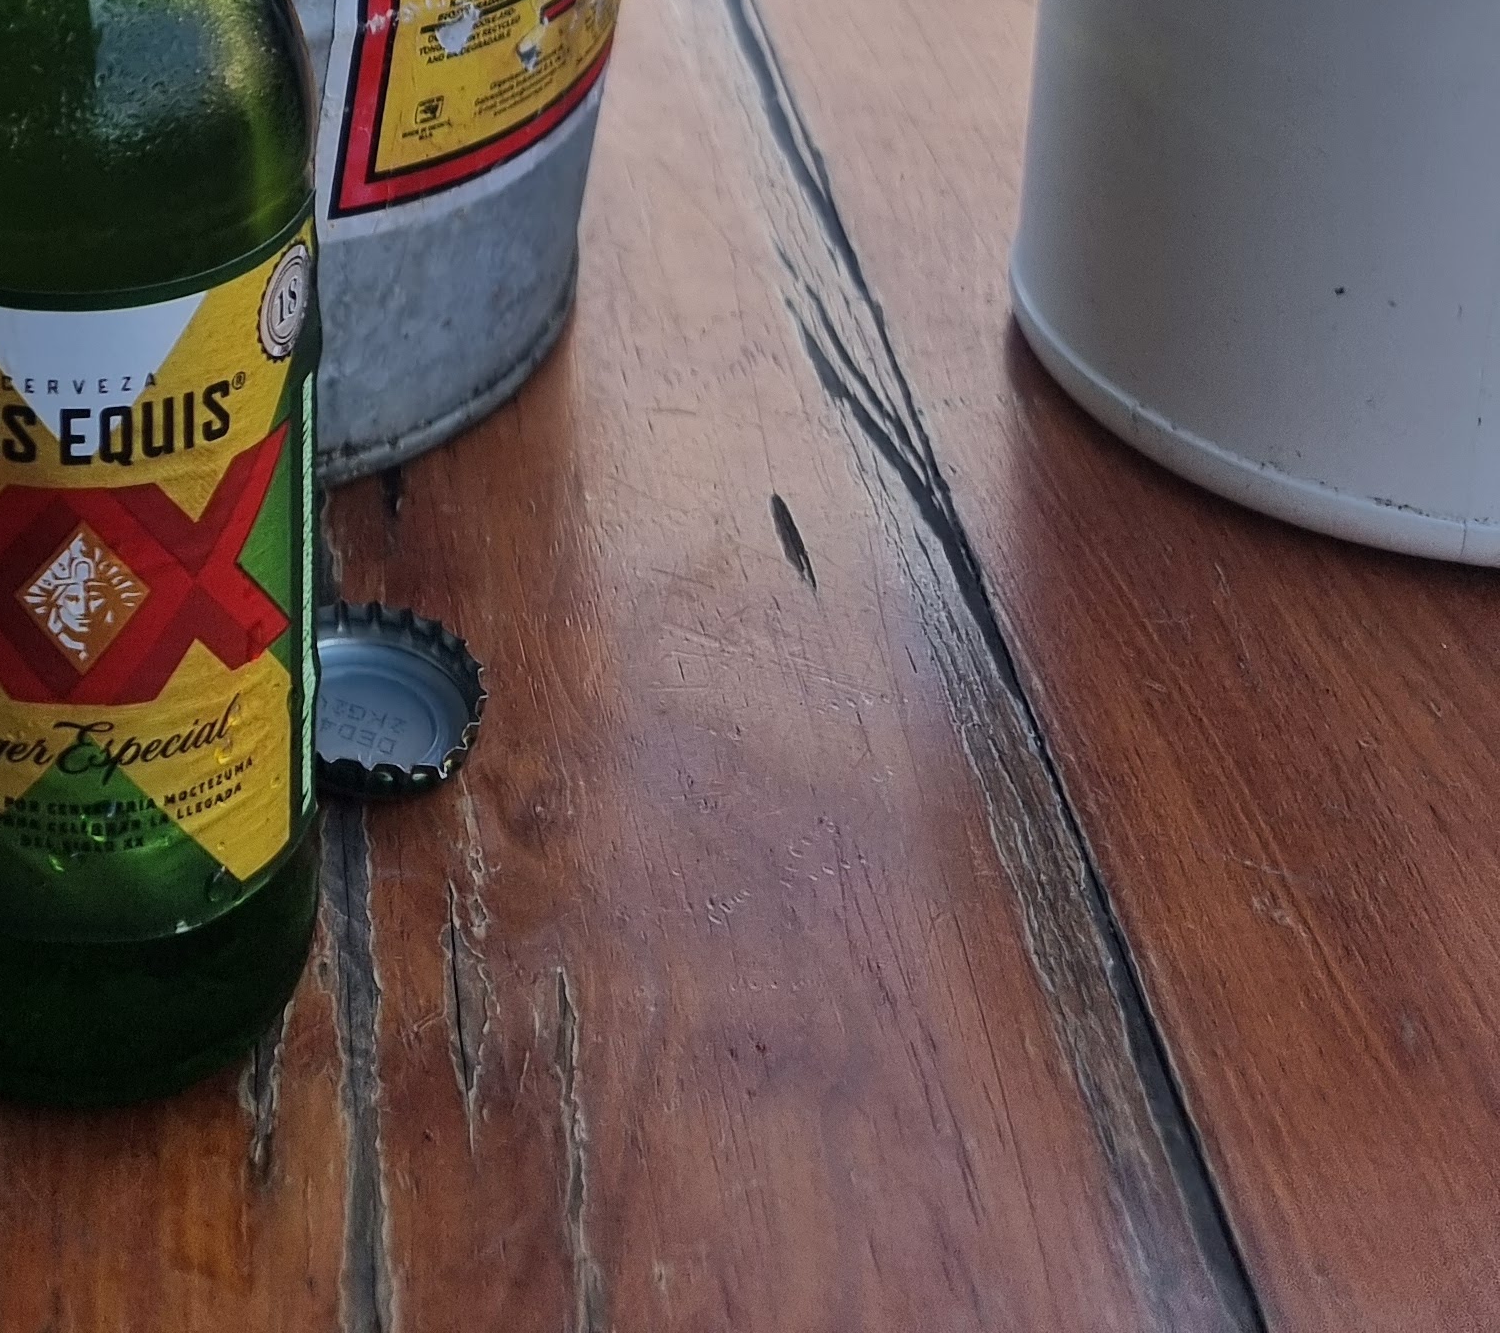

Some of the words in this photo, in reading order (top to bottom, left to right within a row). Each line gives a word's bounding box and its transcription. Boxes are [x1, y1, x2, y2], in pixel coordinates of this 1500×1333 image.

[277, 277, 297, 326] 18
[2, 372, 156, 395] CERVEZA
[53, 691, 242, 783] Especial
[164, 756, 254, 807] MOCTEZUMA
[176, 782, 243, 821] LLEGADA
